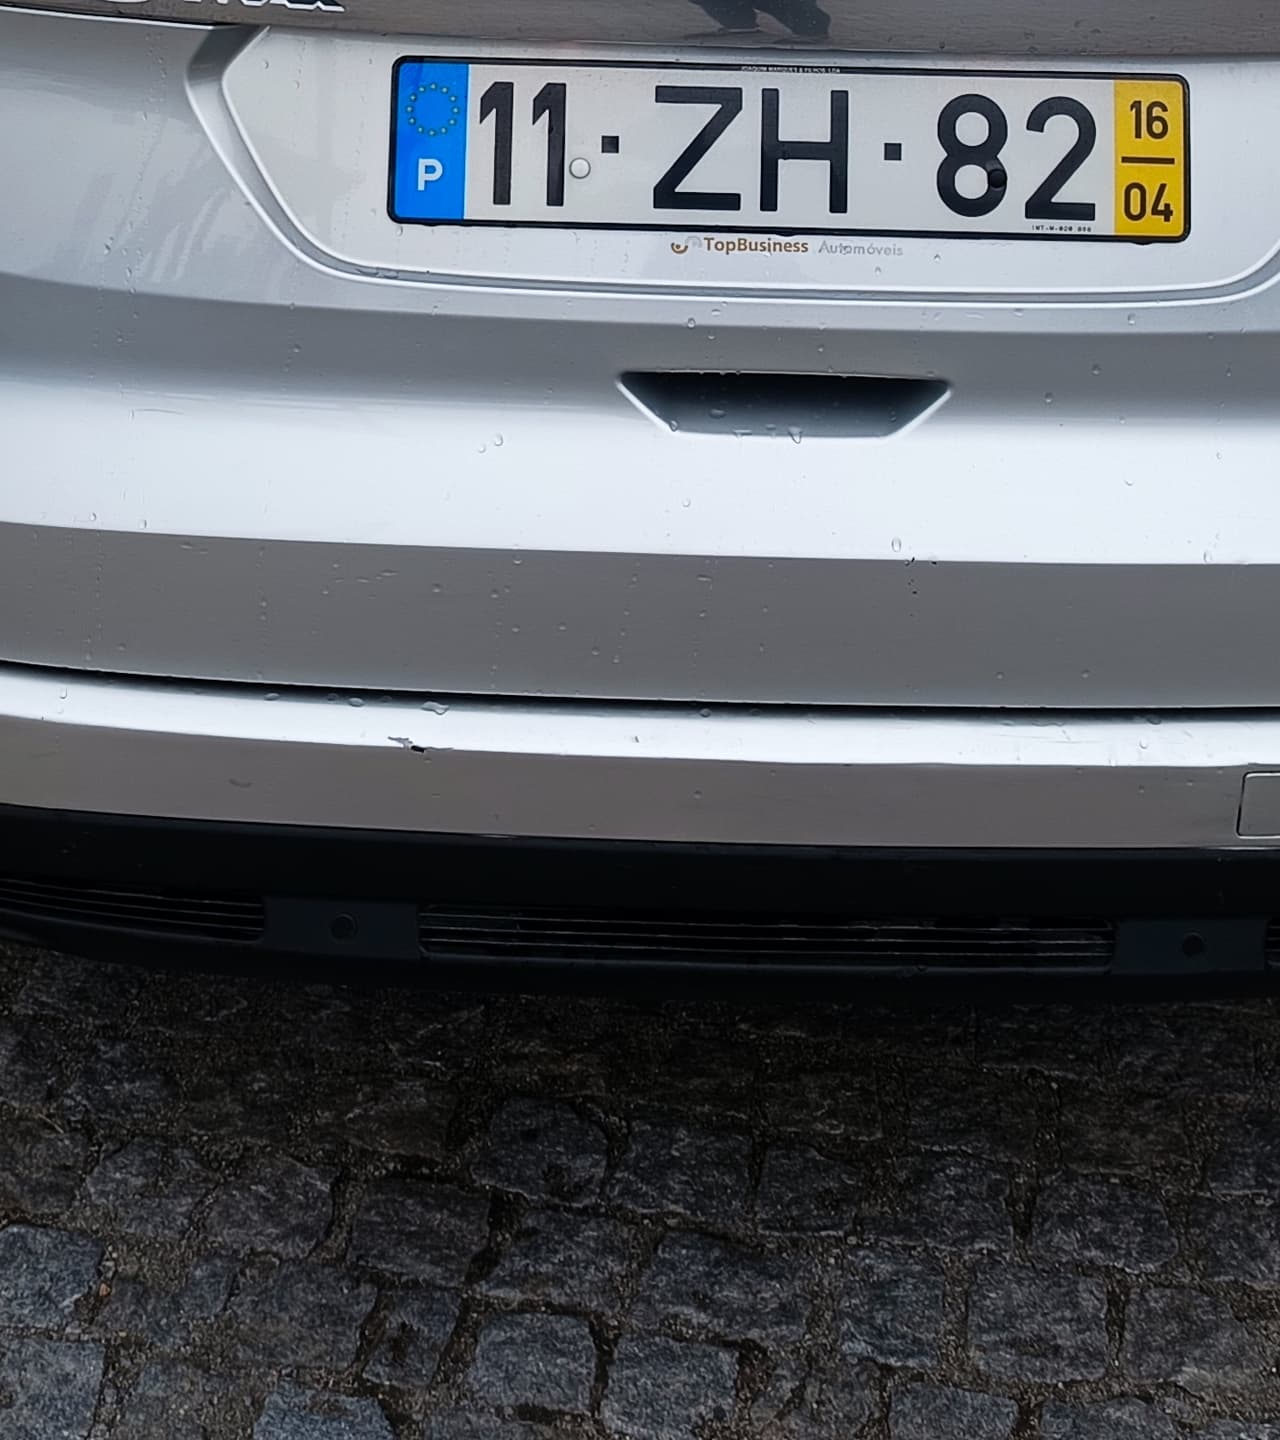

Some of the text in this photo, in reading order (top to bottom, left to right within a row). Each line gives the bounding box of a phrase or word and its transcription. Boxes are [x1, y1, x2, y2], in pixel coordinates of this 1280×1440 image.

[1130, 100, 1169, 140] 16
[417, 158, 443, 191] P
[1123, 181, 1173, 223] 04
[704, 236, 904, 257] TopBusiness Automóveis
